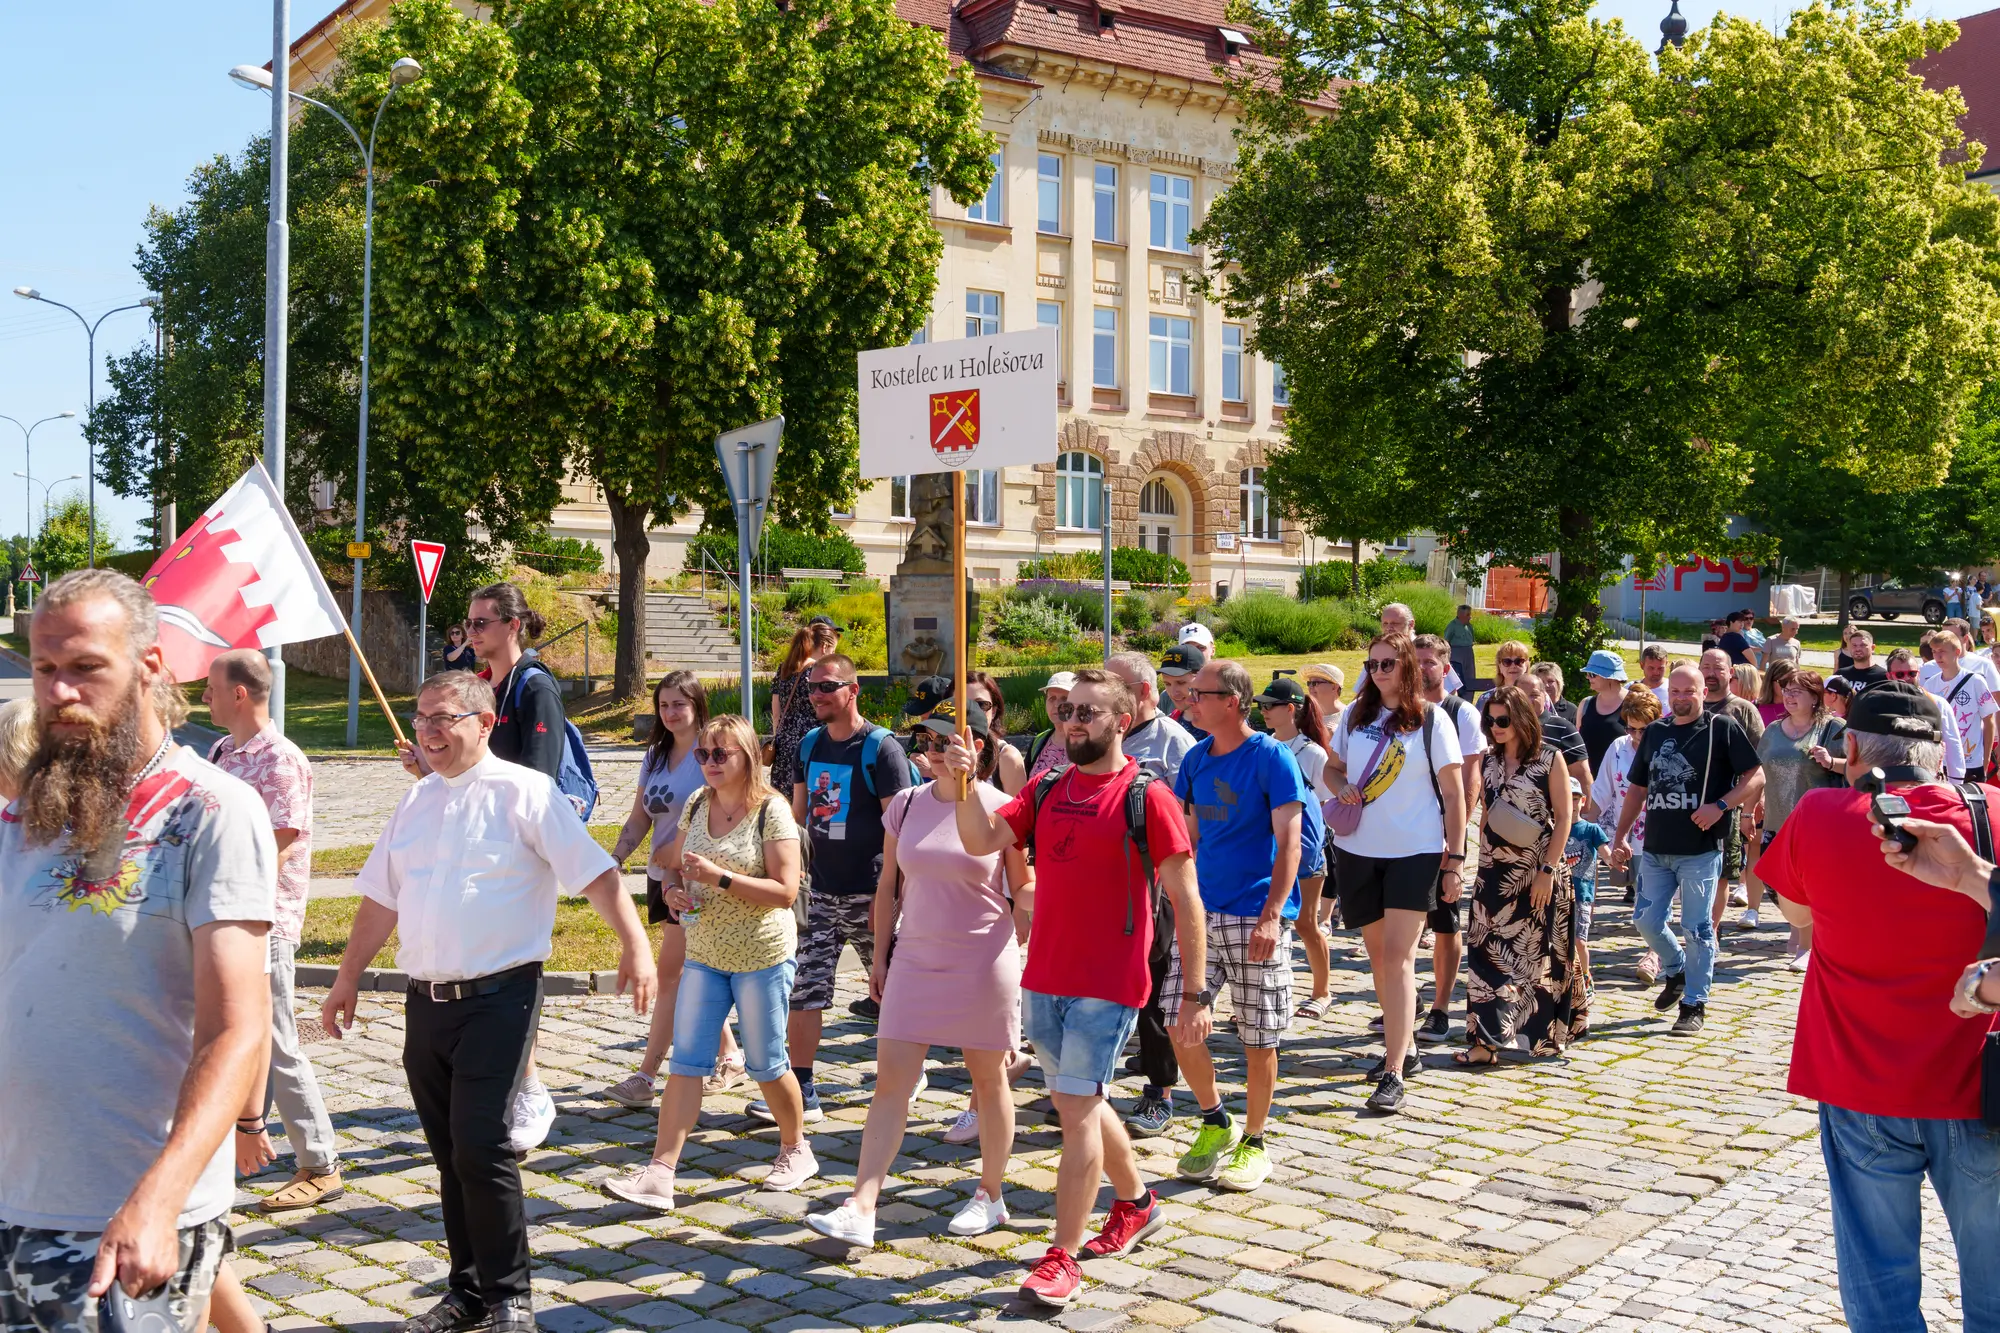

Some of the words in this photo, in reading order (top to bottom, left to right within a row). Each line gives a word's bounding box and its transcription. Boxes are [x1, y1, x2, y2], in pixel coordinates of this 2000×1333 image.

[871, 354, 939, 390] Kostelec
[943, 364, 955, 380] u
[959, 346, 1044, 379] Holešova
[1673, 550, 1759, 593] PSS
[1646, 792, 1698, 811] CASH
